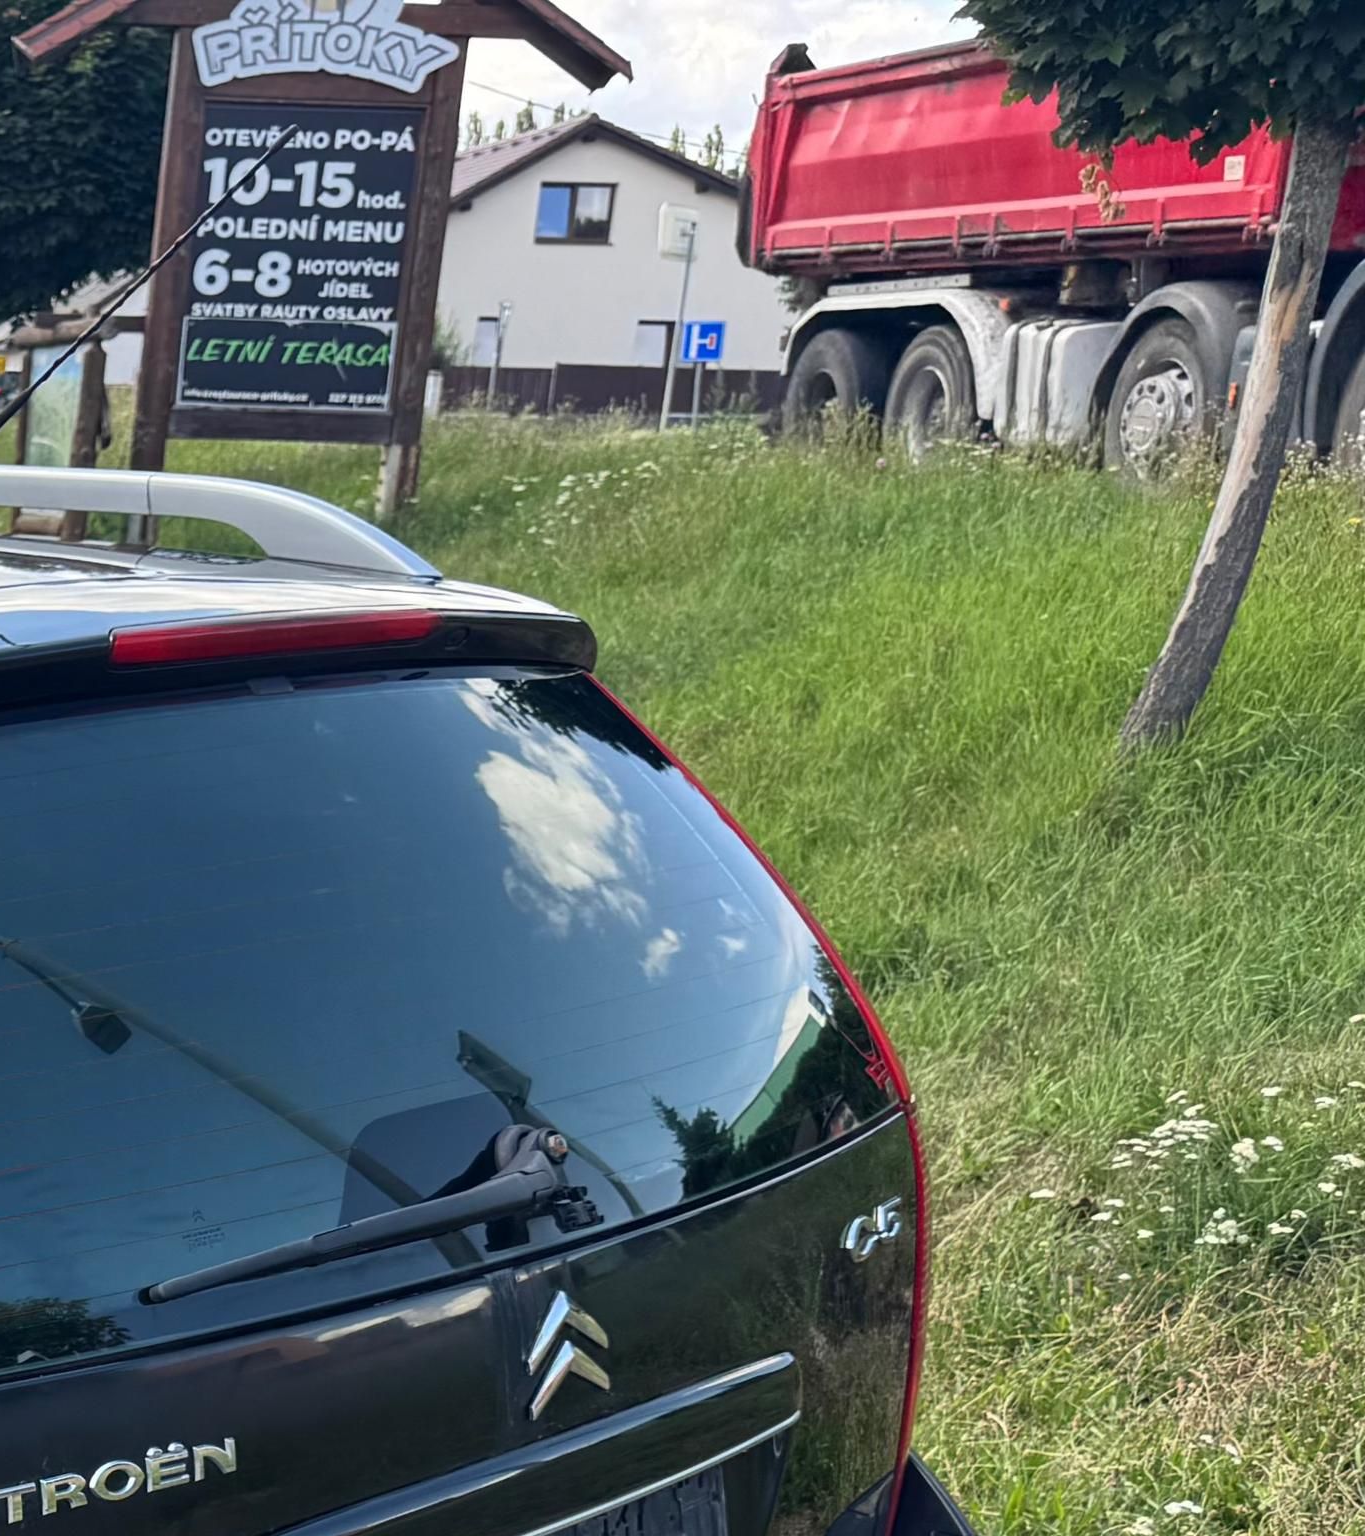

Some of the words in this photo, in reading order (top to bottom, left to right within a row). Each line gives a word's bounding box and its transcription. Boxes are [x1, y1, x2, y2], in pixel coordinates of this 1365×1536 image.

[202, 2, 448, 82] PŘÍTOKY
[334, 126, 415, 151] PO-PÁ
[203, 157, 356, 208] 10-15
[357, 190, 406, 209] hod.
[196, 215, 321, 241] POLEDNÍ
[323, 219, 405, 243] MENU
[193, 248, 292, 298] 6-8
[297, 257, 400, 277] HOTOVÝCH
[318, 280, 373, 299] JÍDEL
[191, 302, 258, 318] SVATBY
[261, 303, 320, 320] RAUTY
[323, 306, 394, 321] OSLAVY
[187, 334, 276, 364] LETNÍ
[281, 341, 390, 367] TERASA
[840, 1193, 903, 1263] C5
